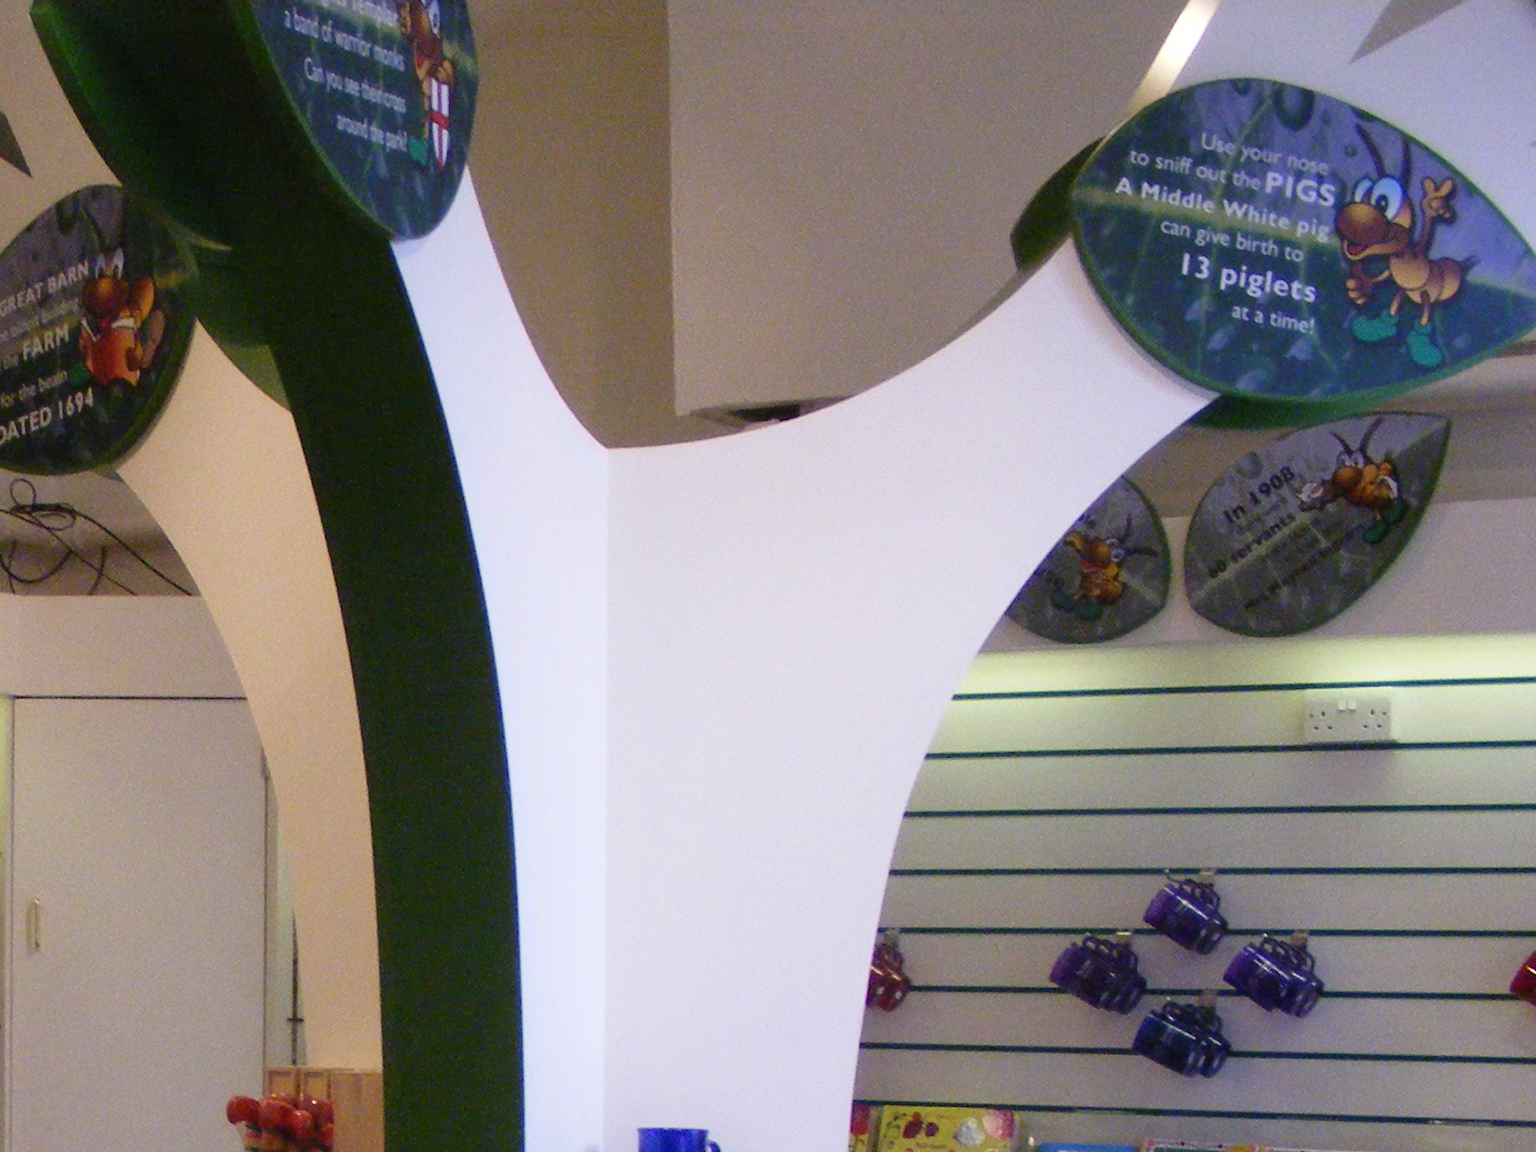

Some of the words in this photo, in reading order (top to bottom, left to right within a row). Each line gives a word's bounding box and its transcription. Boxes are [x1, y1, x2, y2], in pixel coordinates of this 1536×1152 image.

[1201, 132, 1235, 156] Use
[1240, 145, 1282, 164] your
[1287, 155, 1329, 176] nose
[1129, 150, 1150, 167] to
[1154, 156, 1193, 176] sniff
[1196, 165, 1227, 184] out
[1232, 170, 1261, 191] the
[1265, 171, 1336, 207] PIGS
[1115, 176, 1133, 196] A
[1140, 181, 1214, 214] Middle
[1223, 198, 1290, 230] White
[1295, 219, 1330, 244] pig
[1160, 220, 1191, 239] can
[1195, 227, 1230, 247] give
[1235, 232, 1279, 257] birth
[1284, 243, 1304, 263] to
[47, 259, 90, 294] BARN
[1181, 252, 1210, 280] 13
[1219, 264, 1317, 303] piglets
[1231, 304, 1250, 321] at
[1254, 310, 1264, 324] a
[1269, 311, 1315, 335] time!
[22, 323, 71, 361] FARM
[0, 392, 16, 409] for
[19, 383, 36, 401] the
[59, 387, 94, 420] 1694
[1223, 504, 1246, 524] In
[1249, 466, 1295, 506] 1908
[1229, 512, 1296, 564] servants
